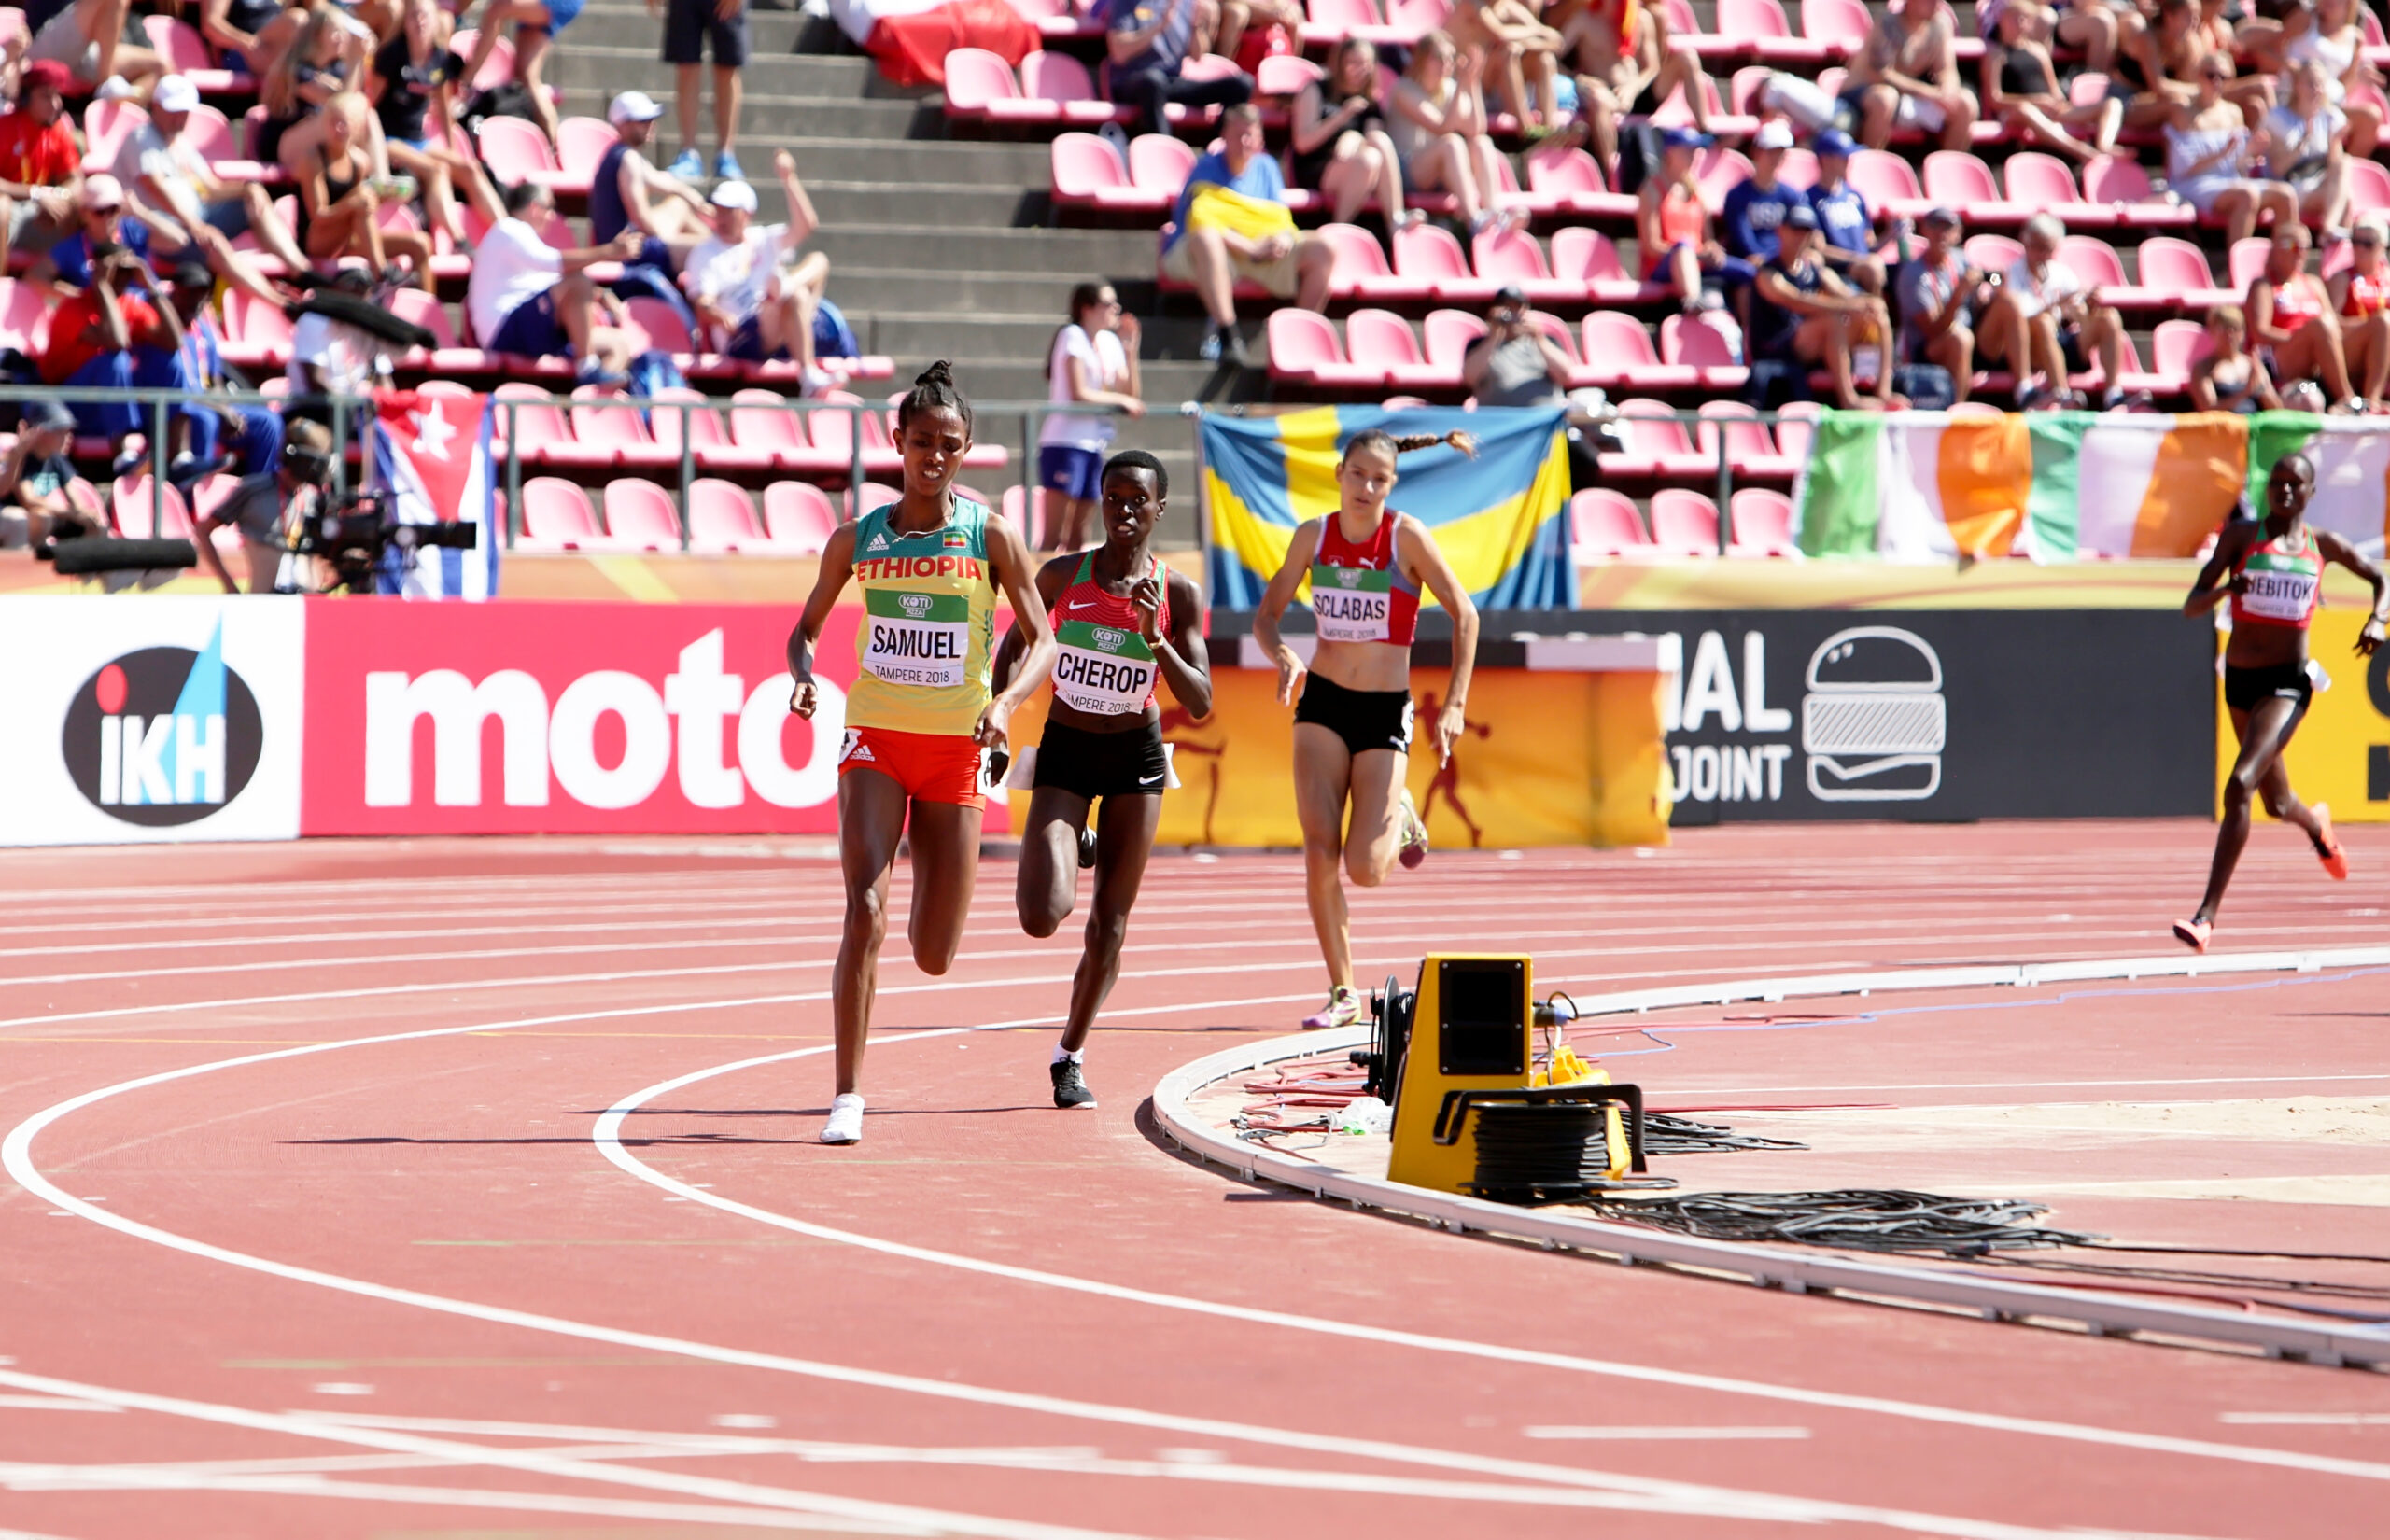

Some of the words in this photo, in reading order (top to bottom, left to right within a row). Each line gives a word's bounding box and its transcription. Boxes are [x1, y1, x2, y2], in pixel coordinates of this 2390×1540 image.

[858, 555, 983, 582] ETHIOPIA
[902, 595, 929, 609] KOTI
[1314, 595, 1385, 621] SCLABAS
[872, 624, 961, 660] SAMUEL
[1095, 629, 1122, 645] KOTI
[875, 665, 922, 682] TAMPERE
[926, 671, 950, 684] 2018
[1057, 652, 1148, 694] CHEROP
[1108, 702, 1131, 713] 2018
[1669, 744, 1792, 802] JOINT
